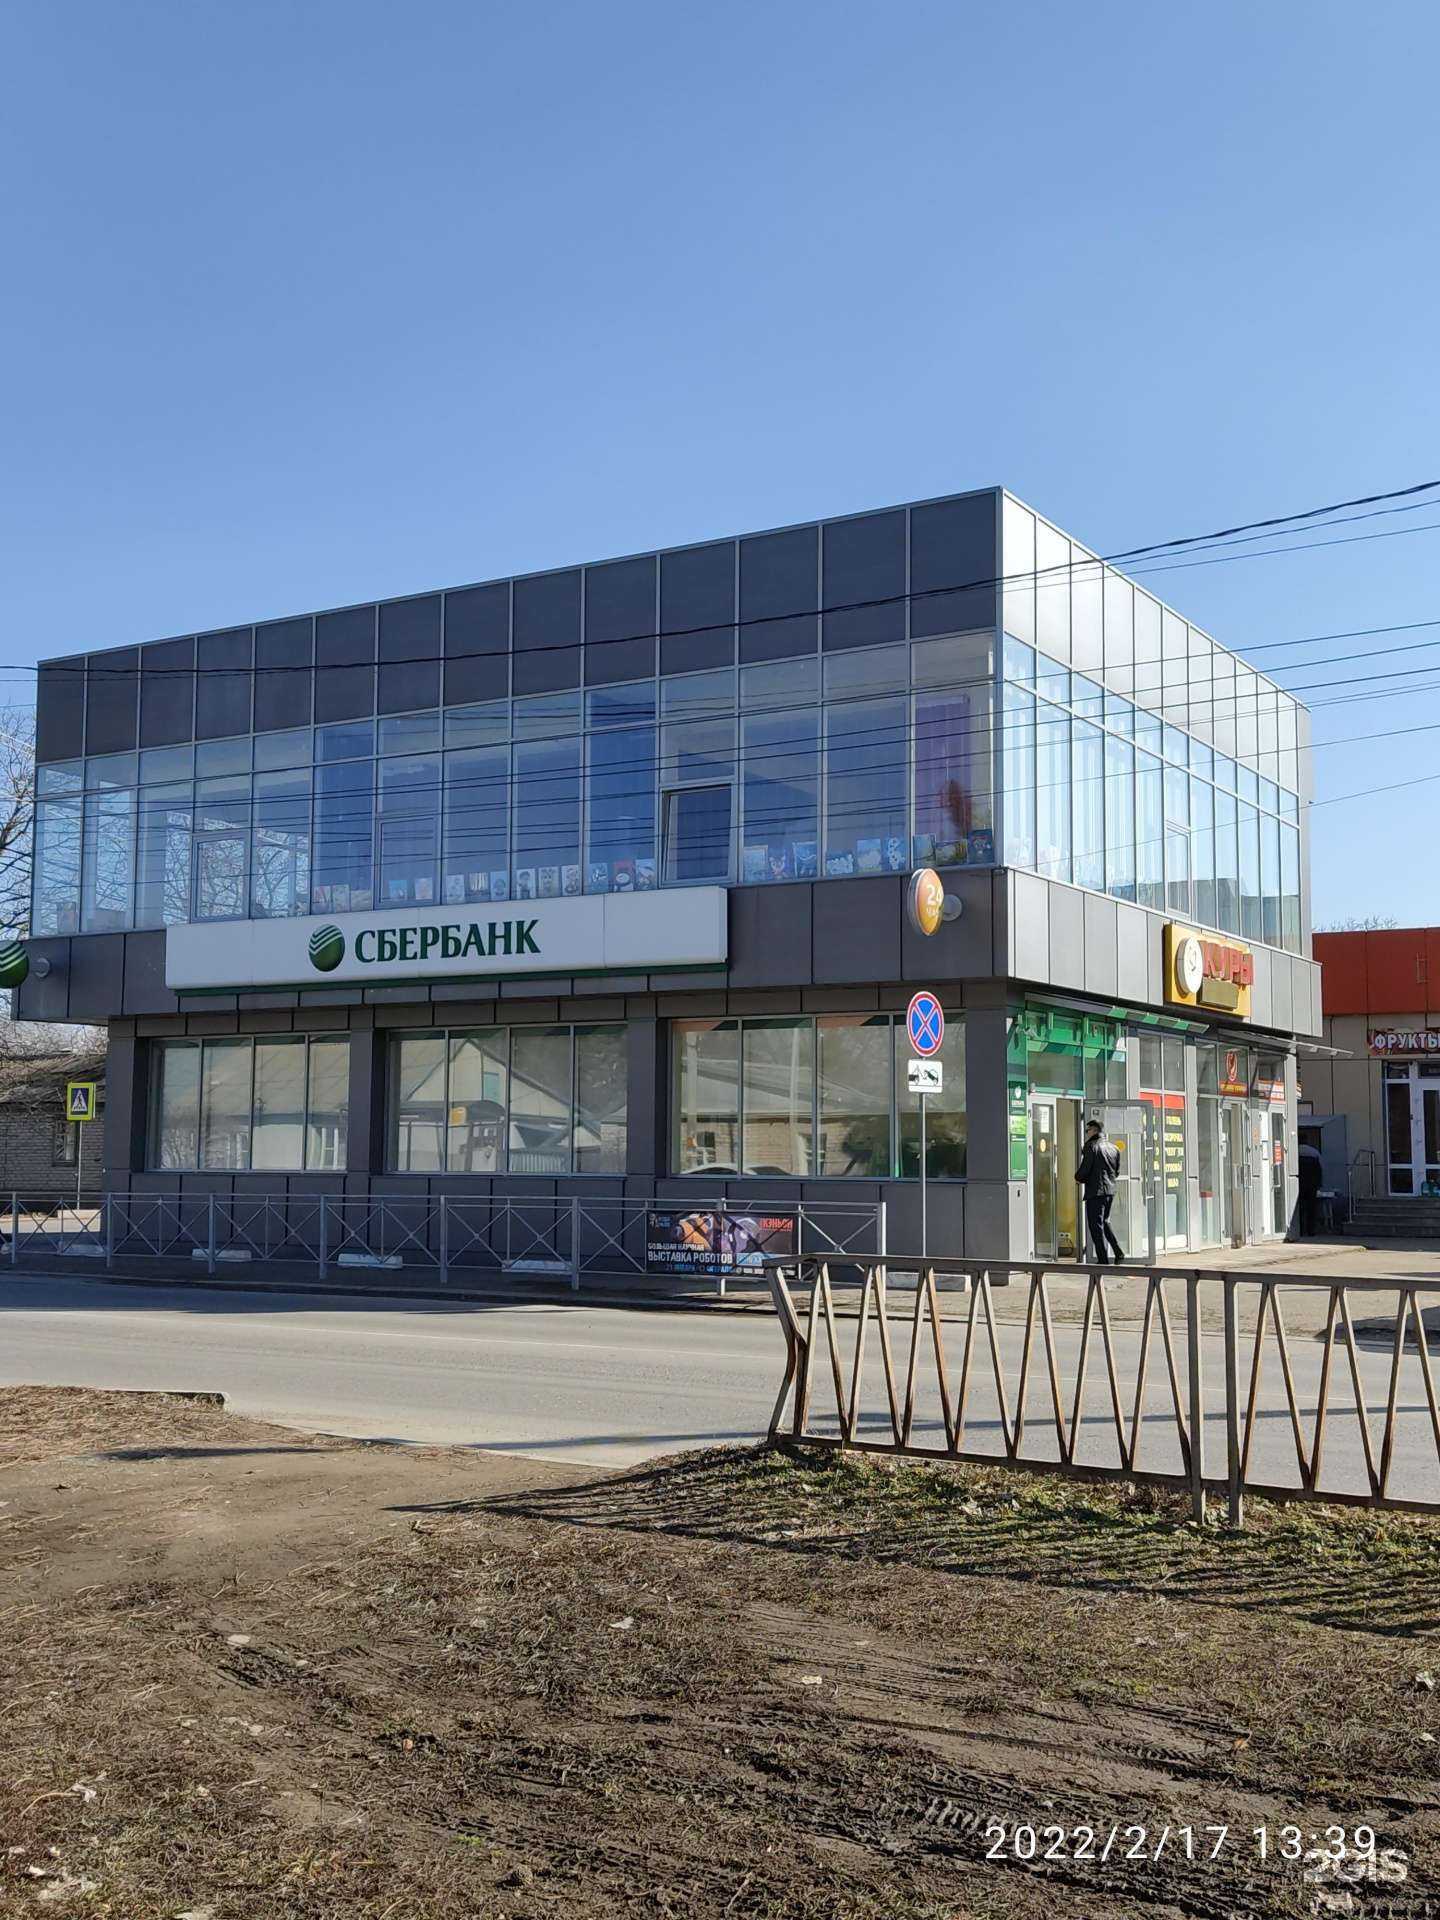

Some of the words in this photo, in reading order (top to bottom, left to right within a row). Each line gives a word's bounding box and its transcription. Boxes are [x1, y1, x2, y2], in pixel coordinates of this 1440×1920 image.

[355, 919, 542, 963] СБЕРБАНК
[648, 1251, 692, 1262] ВЫСТАВКА
[693, 1252, 733, 1264] РОБОТОВ
